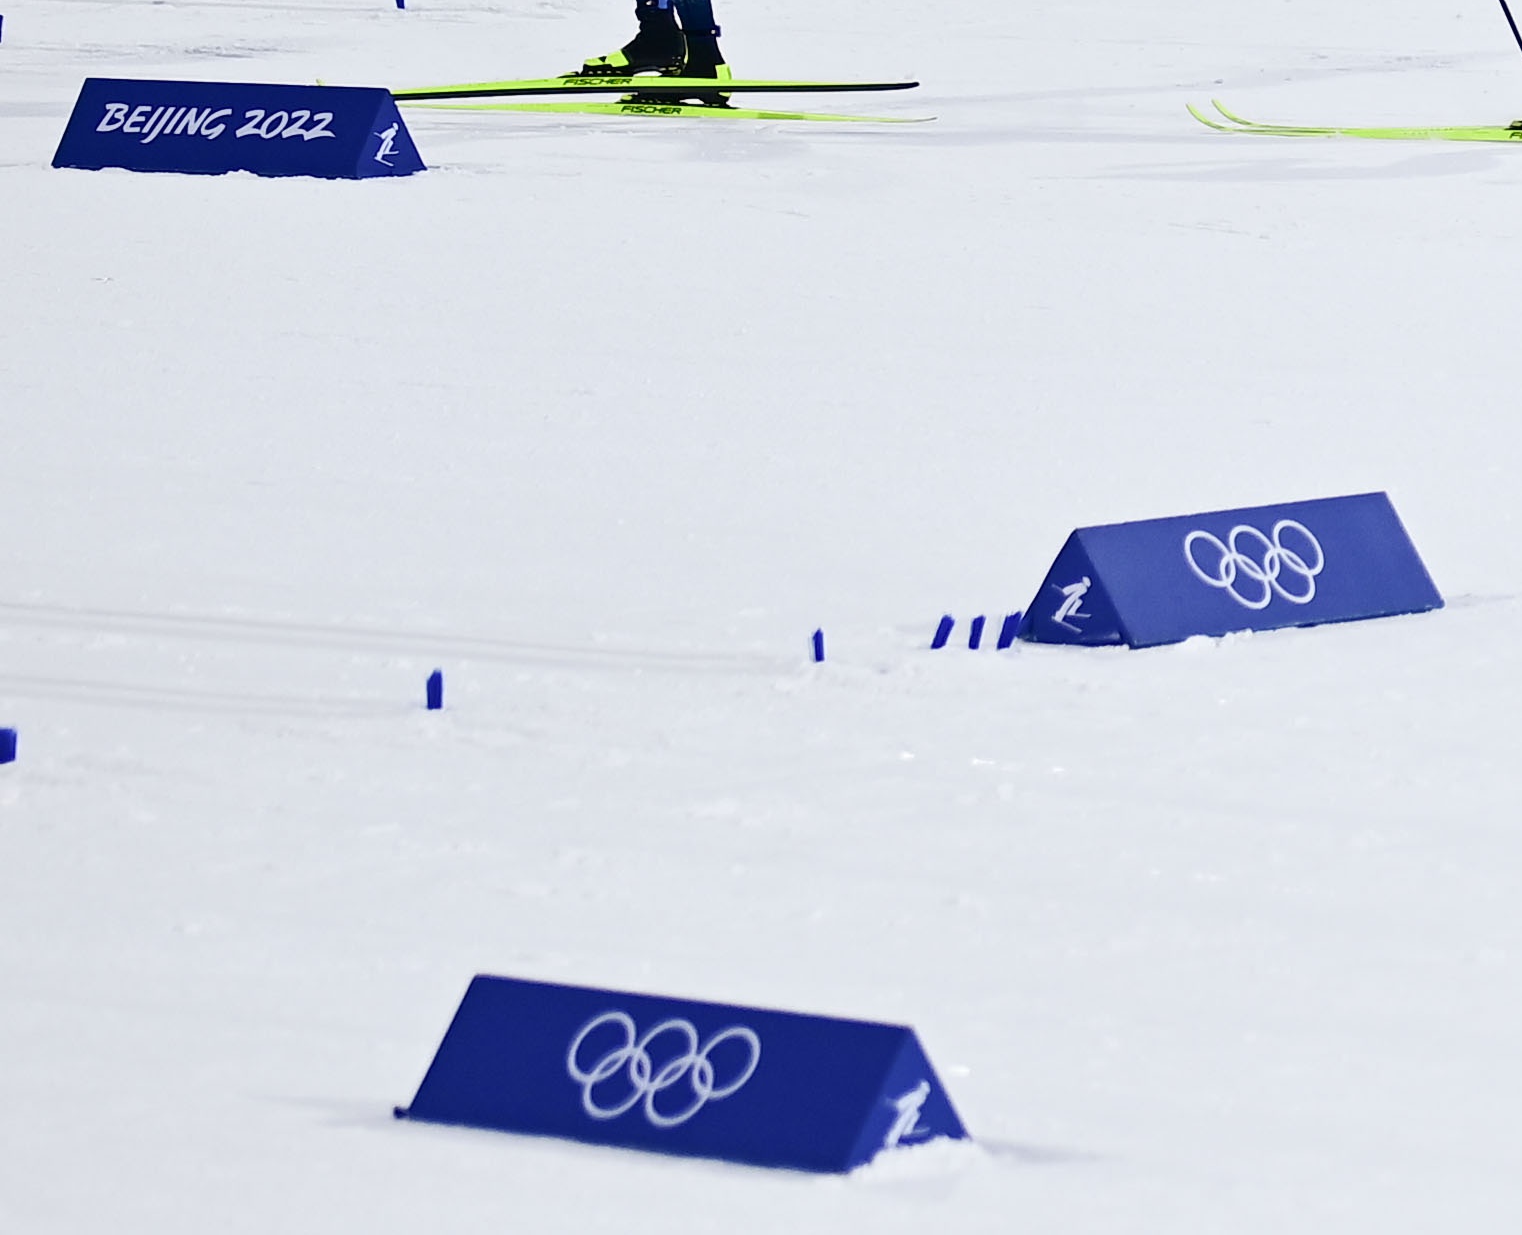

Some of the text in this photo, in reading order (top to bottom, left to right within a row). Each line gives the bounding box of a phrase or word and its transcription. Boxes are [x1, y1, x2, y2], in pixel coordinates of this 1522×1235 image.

[563, 78, 633, 86] FISCHER
[620, 105, 683, 115] FISCHER
[96, 103, 336, 144] BEIJING 2022
